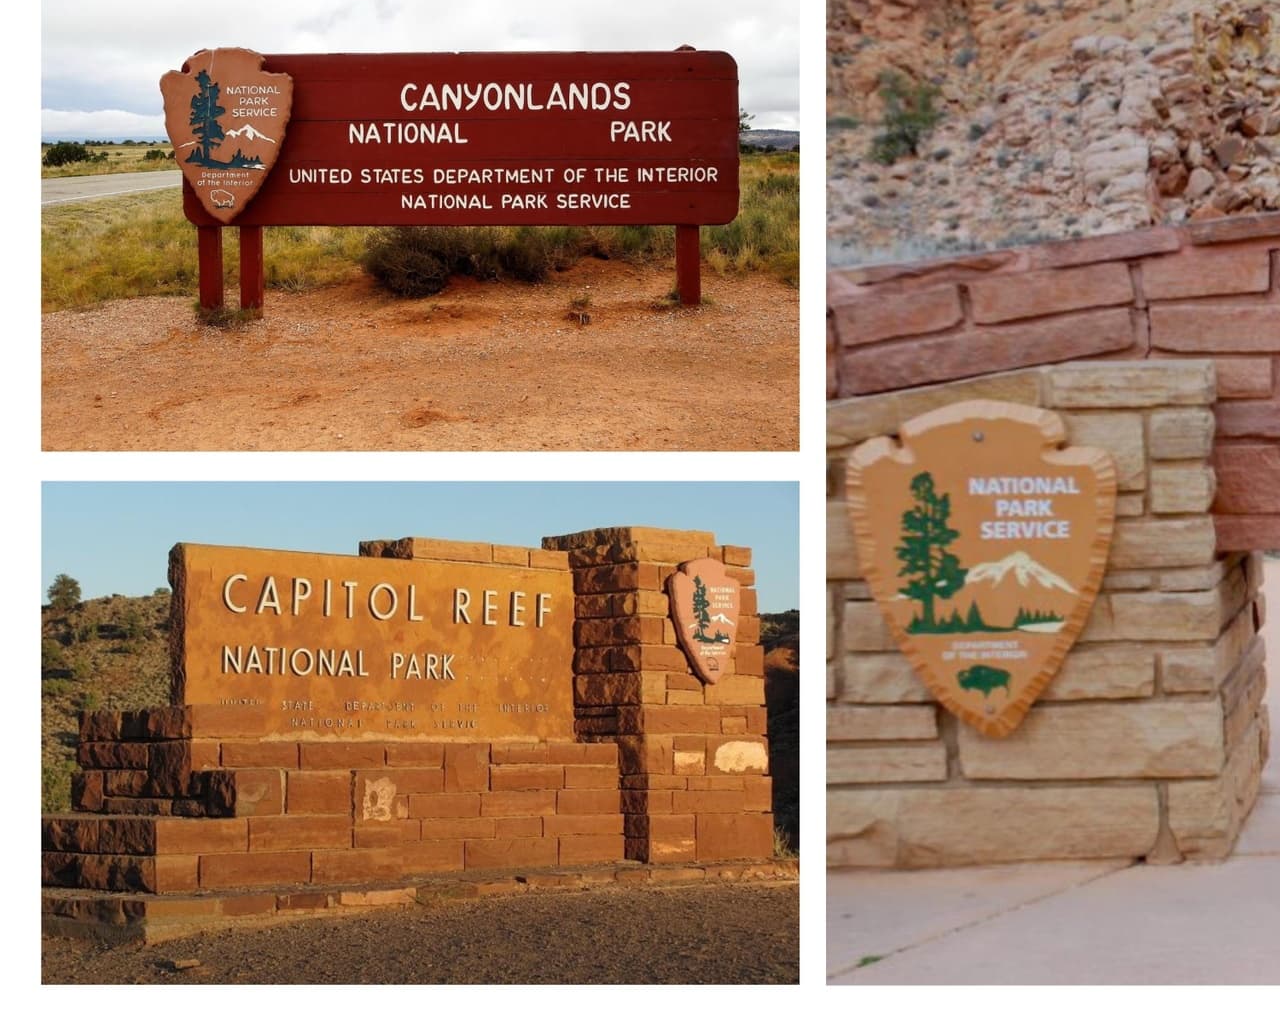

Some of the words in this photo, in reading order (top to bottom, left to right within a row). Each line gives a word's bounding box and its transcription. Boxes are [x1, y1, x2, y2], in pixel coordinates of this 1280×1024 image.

[226, 86, 281, 95] NATIONAL
[400, 82, 632, 111] CANYONLANDS
[239, 97, 269, 106] PARK
[232, 107, 278, 118] SERVICE
[348, 122, 468, 144] NATIONAL
[610, 121, 672, 142] PARK
[289, 168, 352, 184] UNITED
[361, 169, 424, 184] STATES
[433, 168, 555, 184] DEPARTMENT
[563, 168, 587, 183] OF
[593, 167, 629, 183] THE
[637, 167, 719, 182] INTERIOR
[401, 194, 493, 209] NATIONAL
[501, 194, 548, 209] PARK
[556, 194, 631, 209] SERVICE
[968, 477, 1081, 495] NATIONAL
[995, 499, 1053, 517] PARK
[980, 521, 1071, 540] SERVICE
[222, 573, 424, 622] CAPITOL
[453, 588, 553, 628] REEF
[222, 645, 369, 677] NATIONAL
[389, 653, 456, 680] PARK
